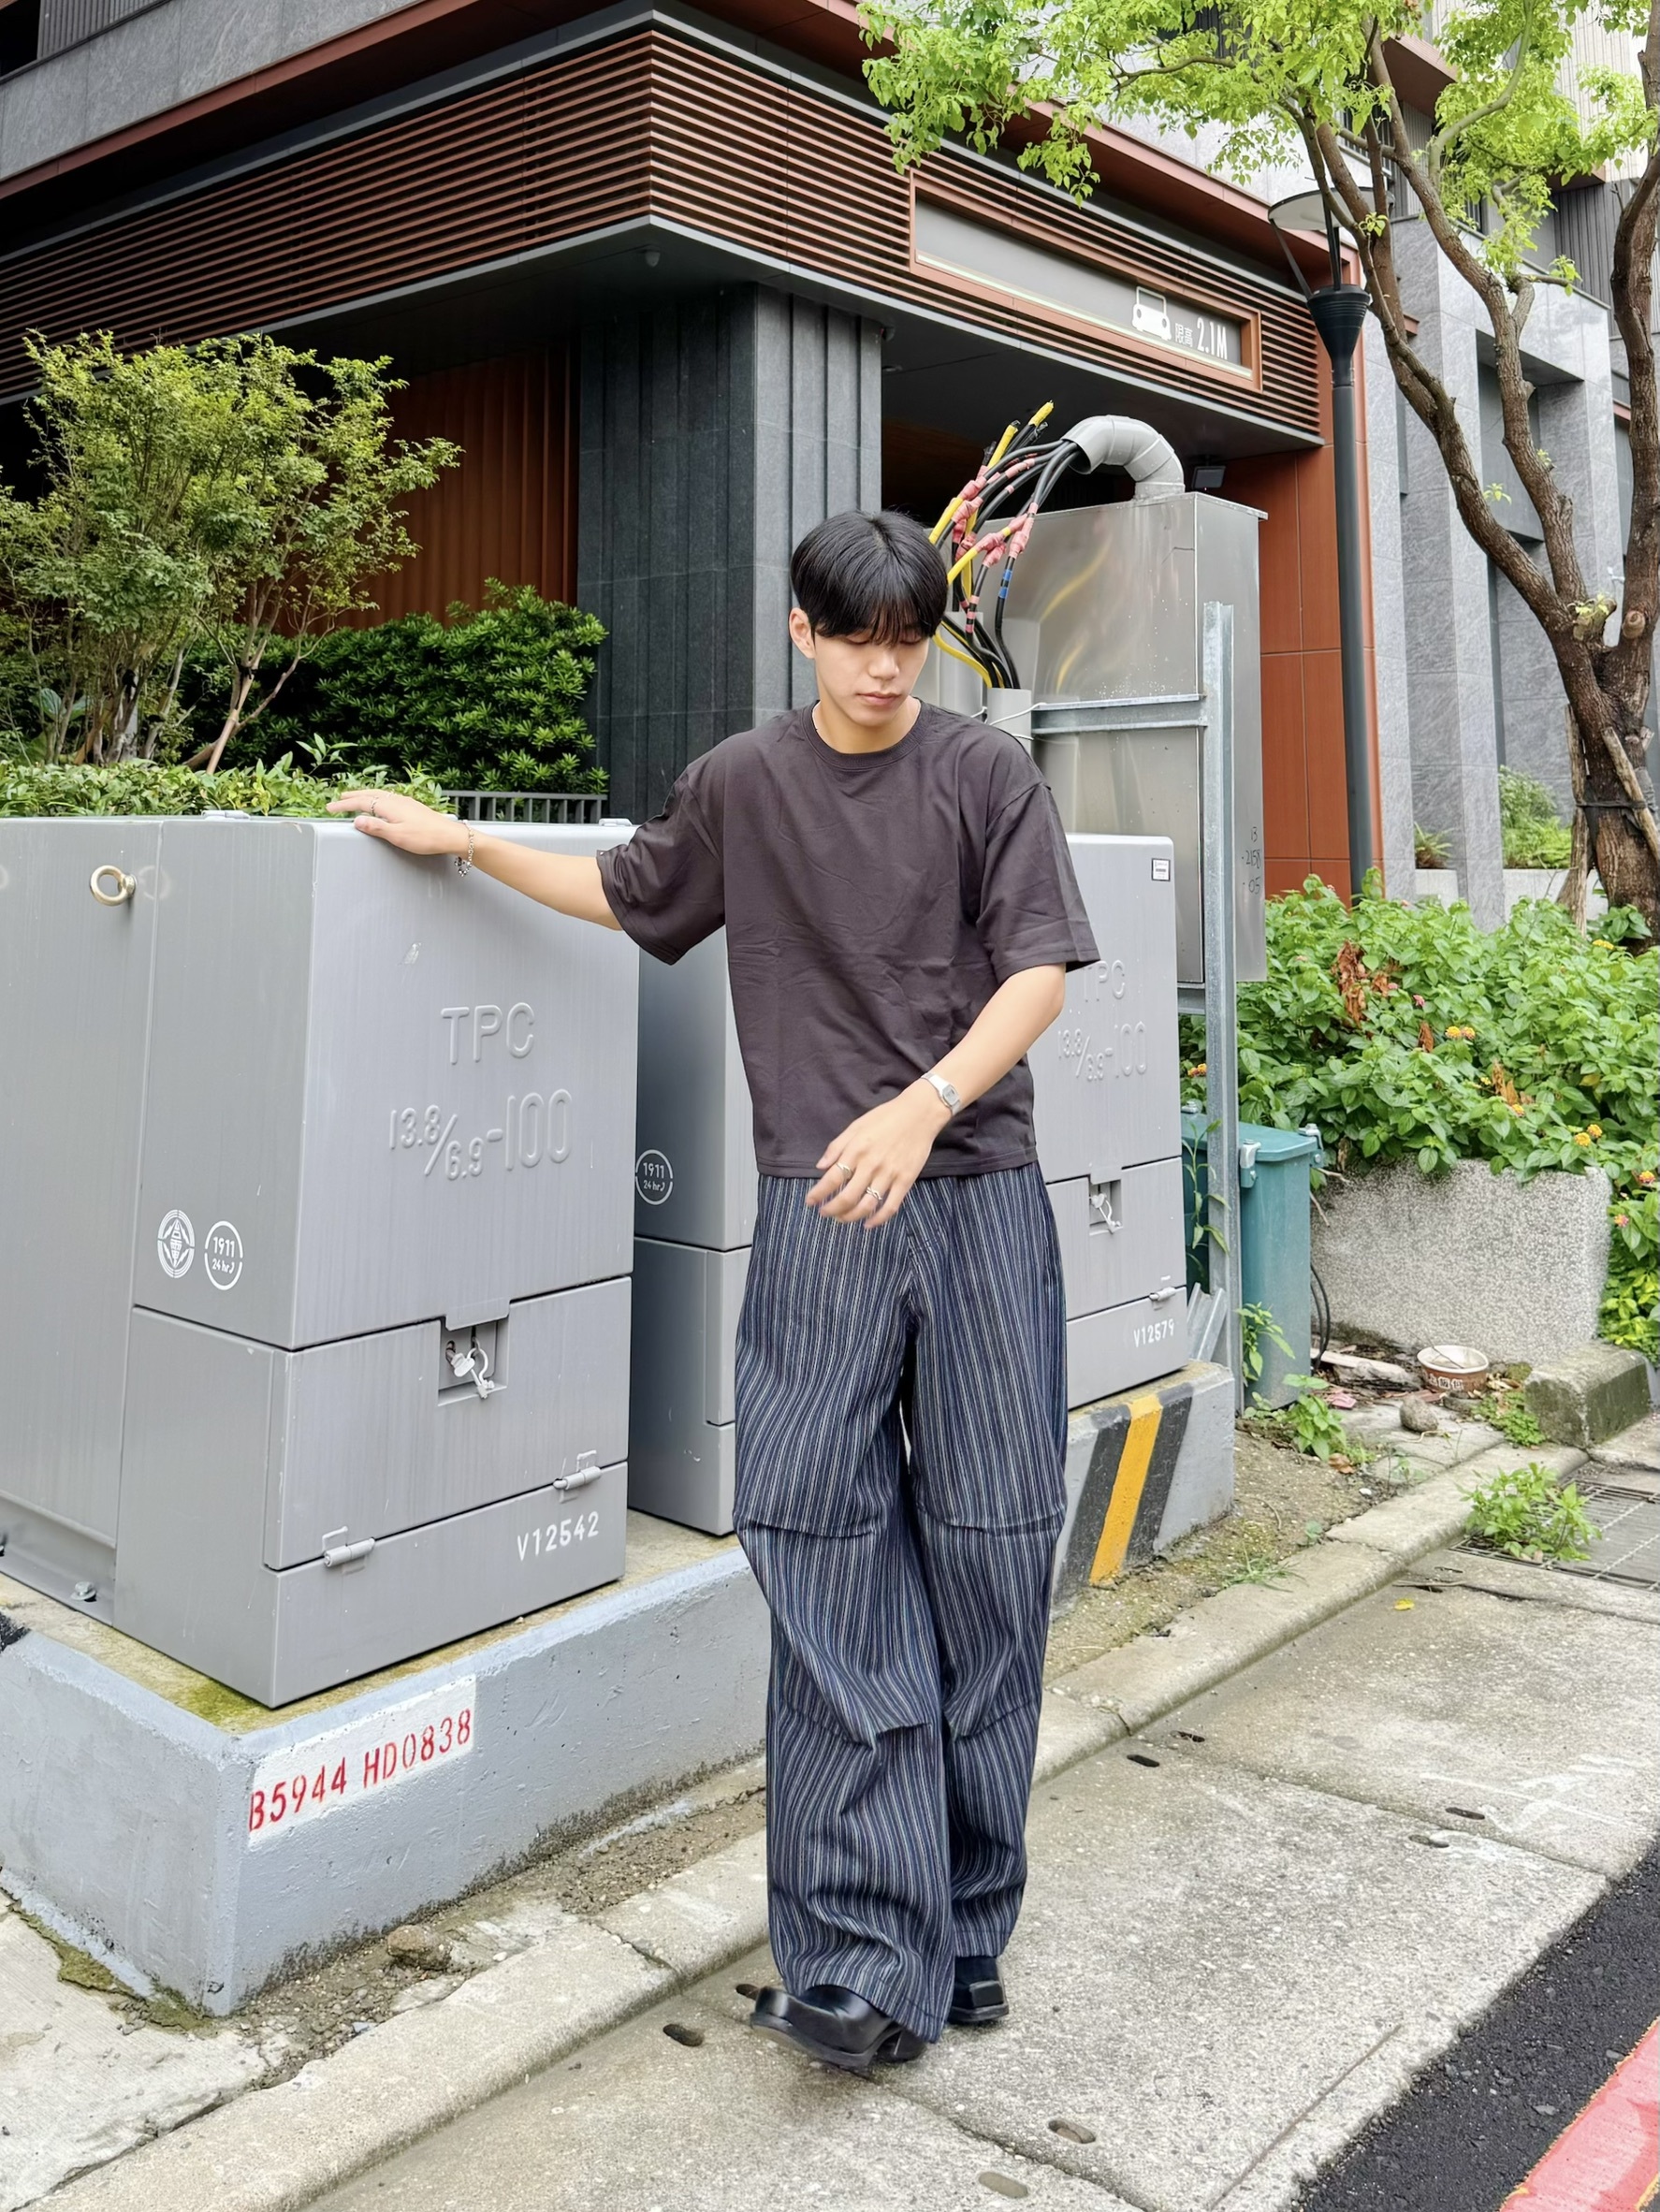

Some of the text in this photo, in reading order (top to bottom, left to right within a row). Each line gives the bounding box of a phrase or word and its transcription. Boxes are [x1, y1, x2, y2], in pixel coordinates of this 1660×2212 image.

[1174, 316, 1228, 360] 限高 2.1M
[441, 1001, 535, 1066] TPC
[643, 1162, 664, 1179] 1911
[212, 1236, 235, 1259] 1911
[1133, 1317, 1174, 1348] V12579
[517, 1510, 599, 1562] V12542
[249, 1709, 472, 1832] B5944 HD0838
